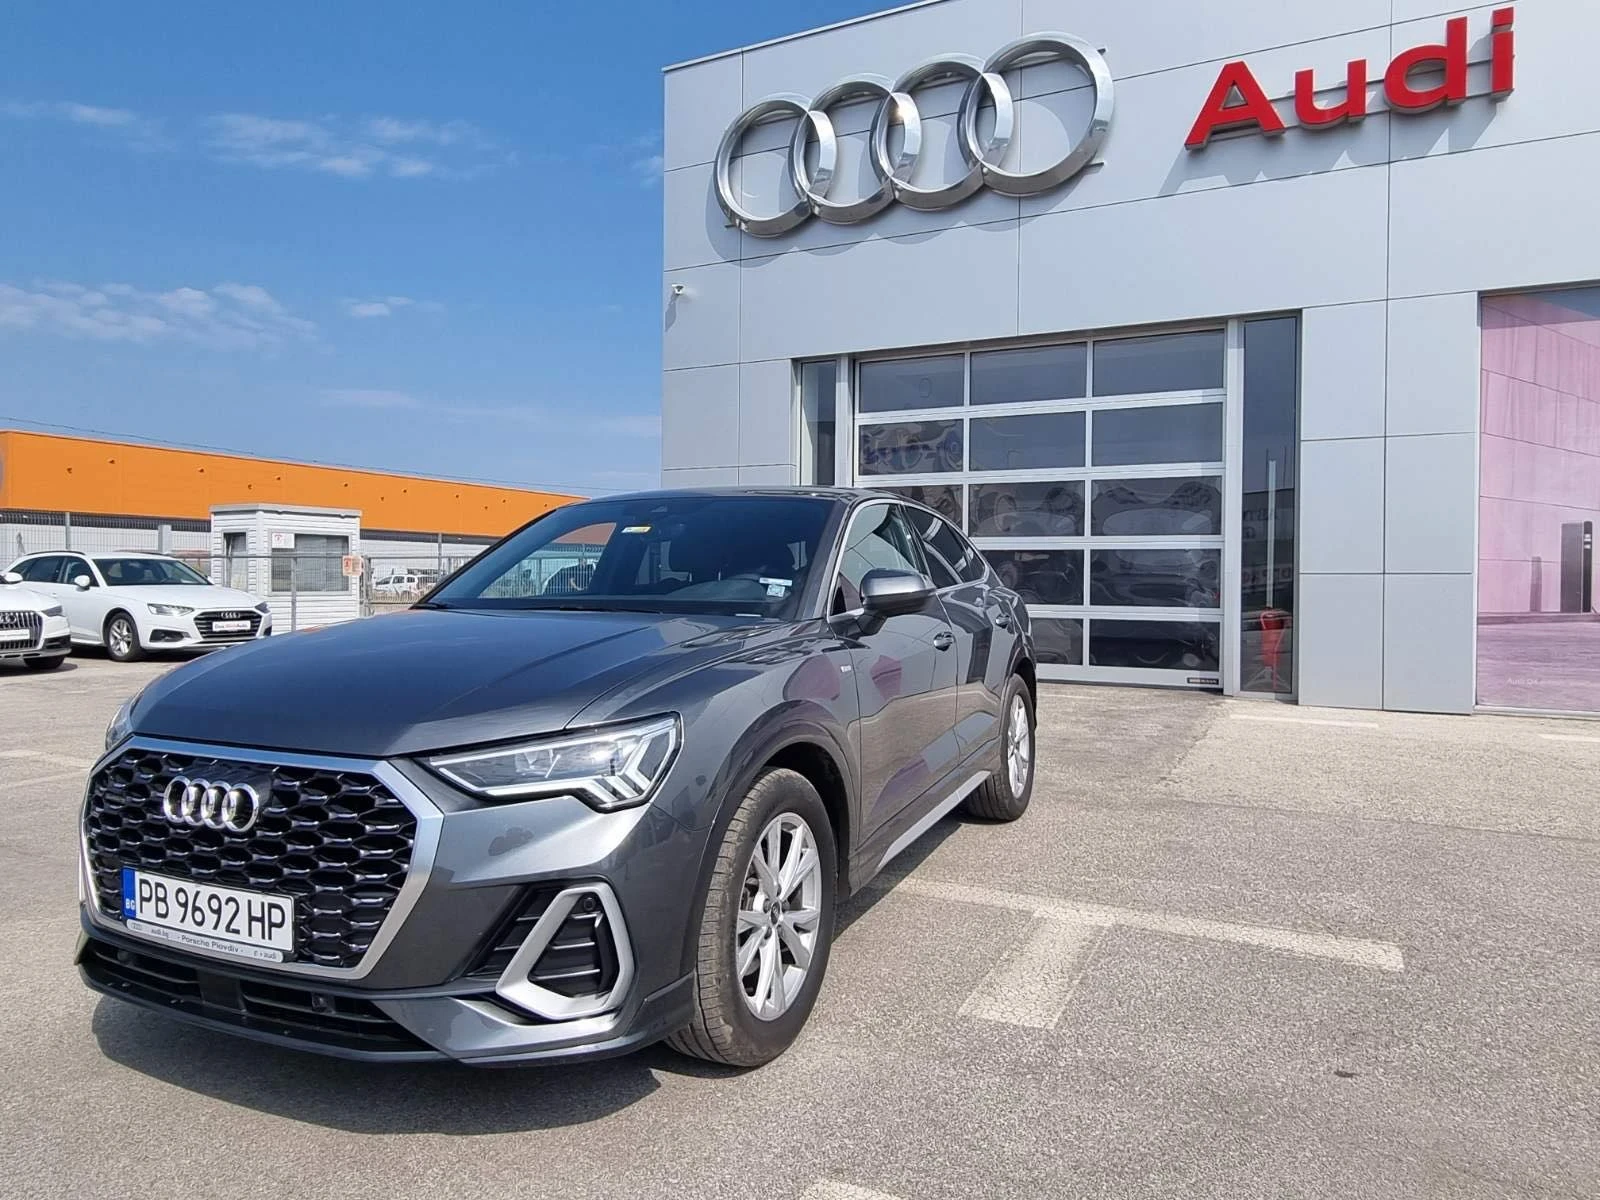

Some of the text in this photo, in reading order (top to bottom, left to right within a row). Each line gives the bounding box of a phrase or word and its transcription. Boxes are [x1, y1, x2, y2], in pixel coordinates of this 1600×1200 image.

[1184, 6, 1515, 149] Audi
[125, 898, 136, 910] BG
[139, 878, 286, 941] PB 9692 HP
